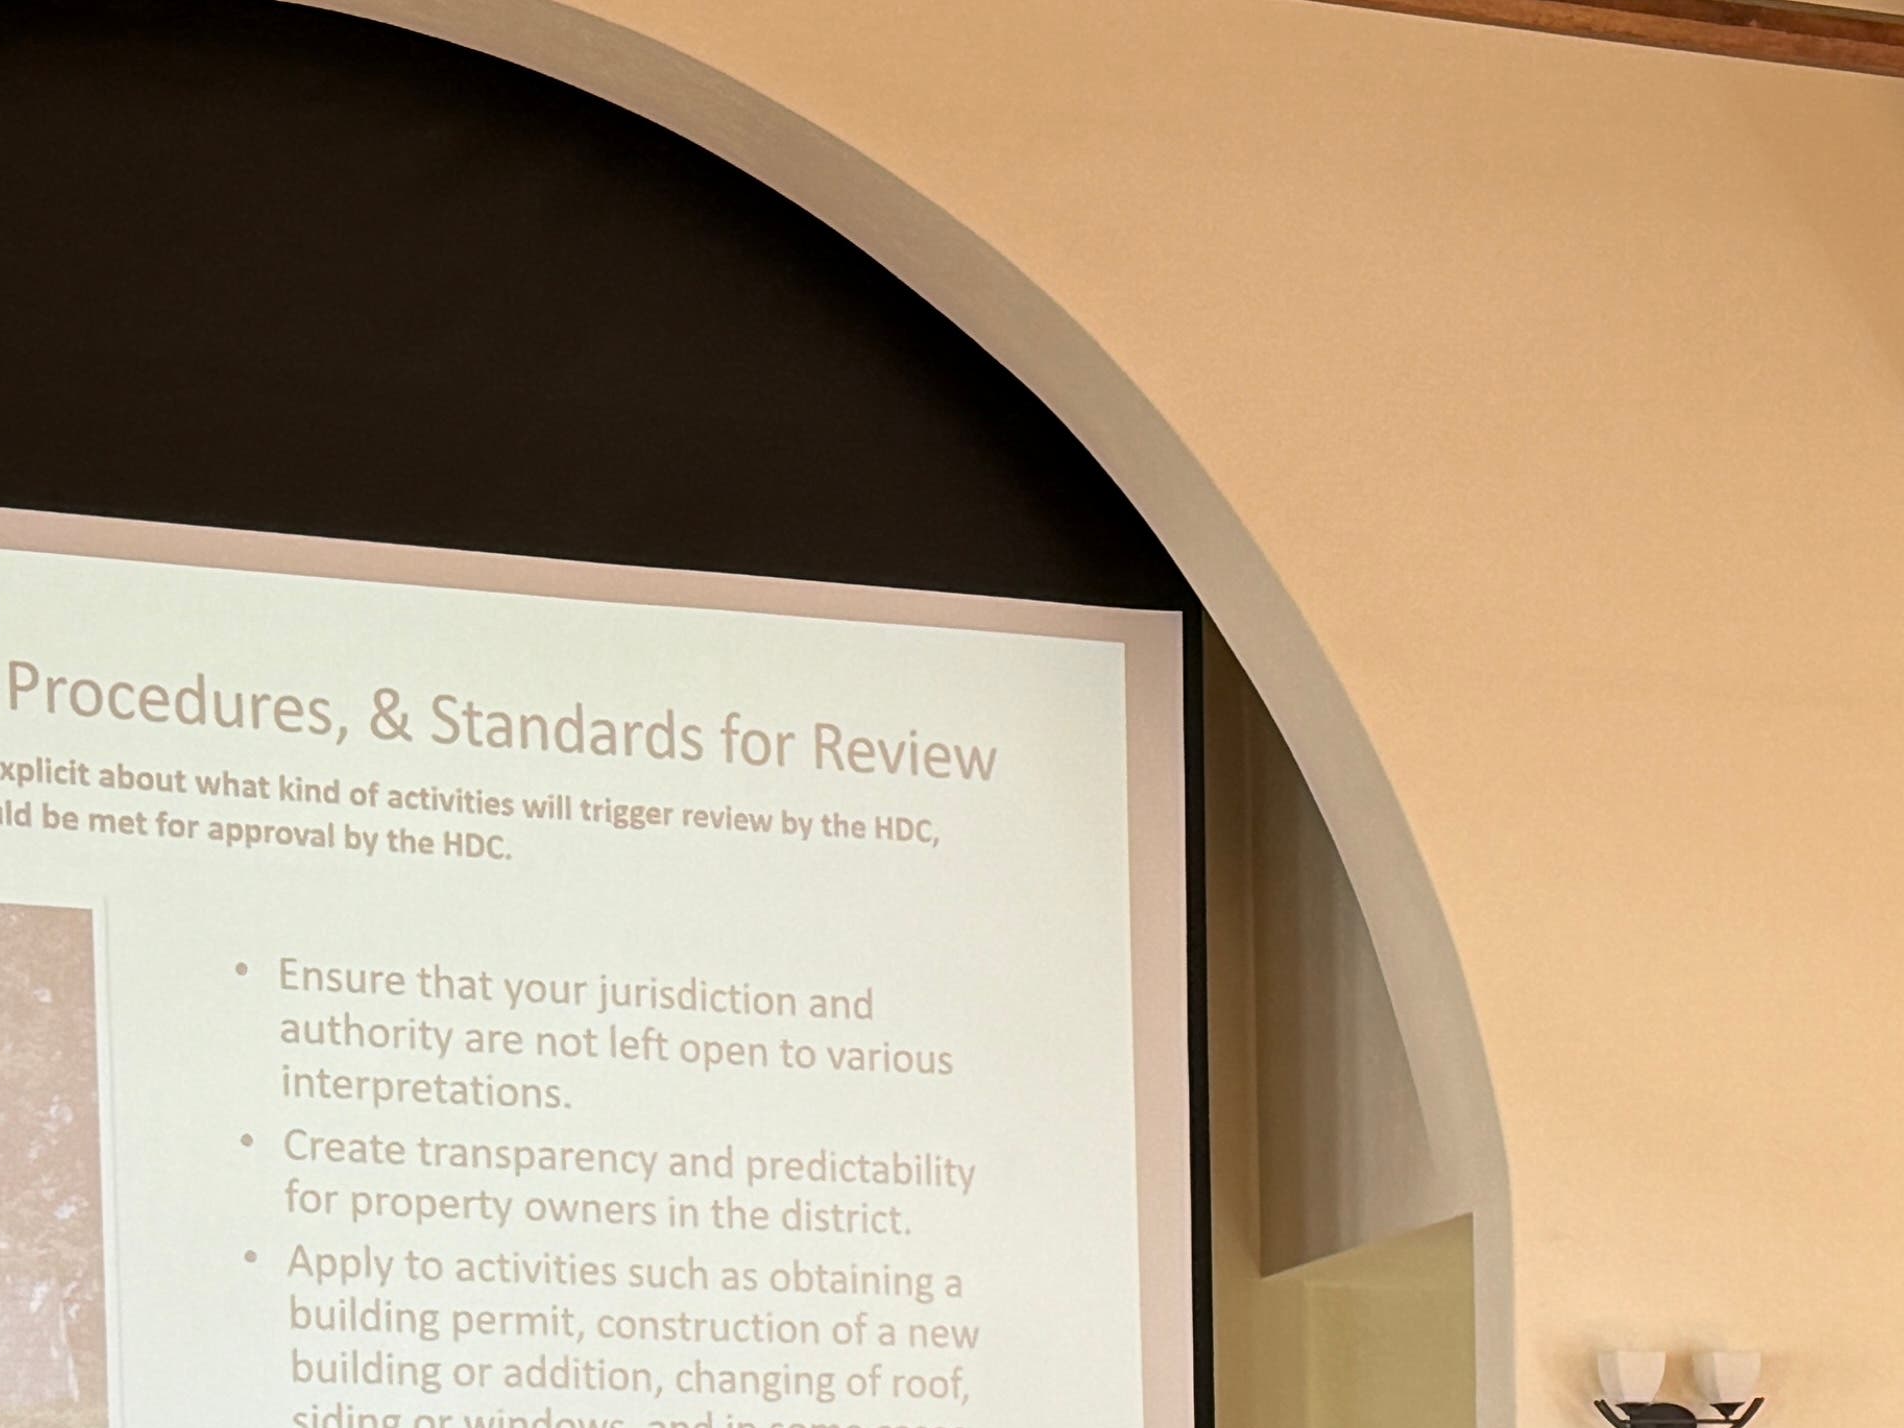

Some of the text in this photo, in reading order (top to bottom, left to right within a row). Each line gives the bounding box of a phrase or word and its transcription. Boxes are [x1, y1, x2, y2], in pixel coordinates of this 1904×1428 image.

[7, 659, 349, 747] Procedures,
[369, 686, 414, 743] &
[430, 693, 705, 763] Standards
[719, 710, 797, 768] for
[813, 721, 998, 782] Review
[41, 801, 80, 832] be
[87, 810, 149, 837] met
[154, 809, 201, 840] for
[206, 820, 336, 850] approval
[343, 822, 380, 858] by
[385, 826, 436, 856] the
[442, 829, 513, 861] HDC.
[97, 761, 188, 795] about
[194, 769, 271, 801] what
[278, 773, 341, 806] kind
[348, 780, 381, 808] of
[386, 784, 516, 818] activities
[521, 793, 573, 822] will
[579, 796, 675, 831] trigger
[681, 804, 774, 834] review
[780, 808, 814, 842] by
[819, 811, 867, 840] the
[874, 815, 940, 849] HDC,
[279, 956, 874, 1021] Ensure that your jurisdiction and
[279, 1010, 954, 1076] authority are not left open to various
[281, 1063, 573, 1110] interpretations.
[283, 1127, 977, 1197] Create transparency and predictability
[283, 1176, 912, 1237] for property owners in the district.
[286, 1243, 963, 1306] Apply to activities such as obtaining a
[289, 1292, 981, 1350] building permit, construction of a new
[290, 1346, 970, 1407] building or addition, changing of roof,
